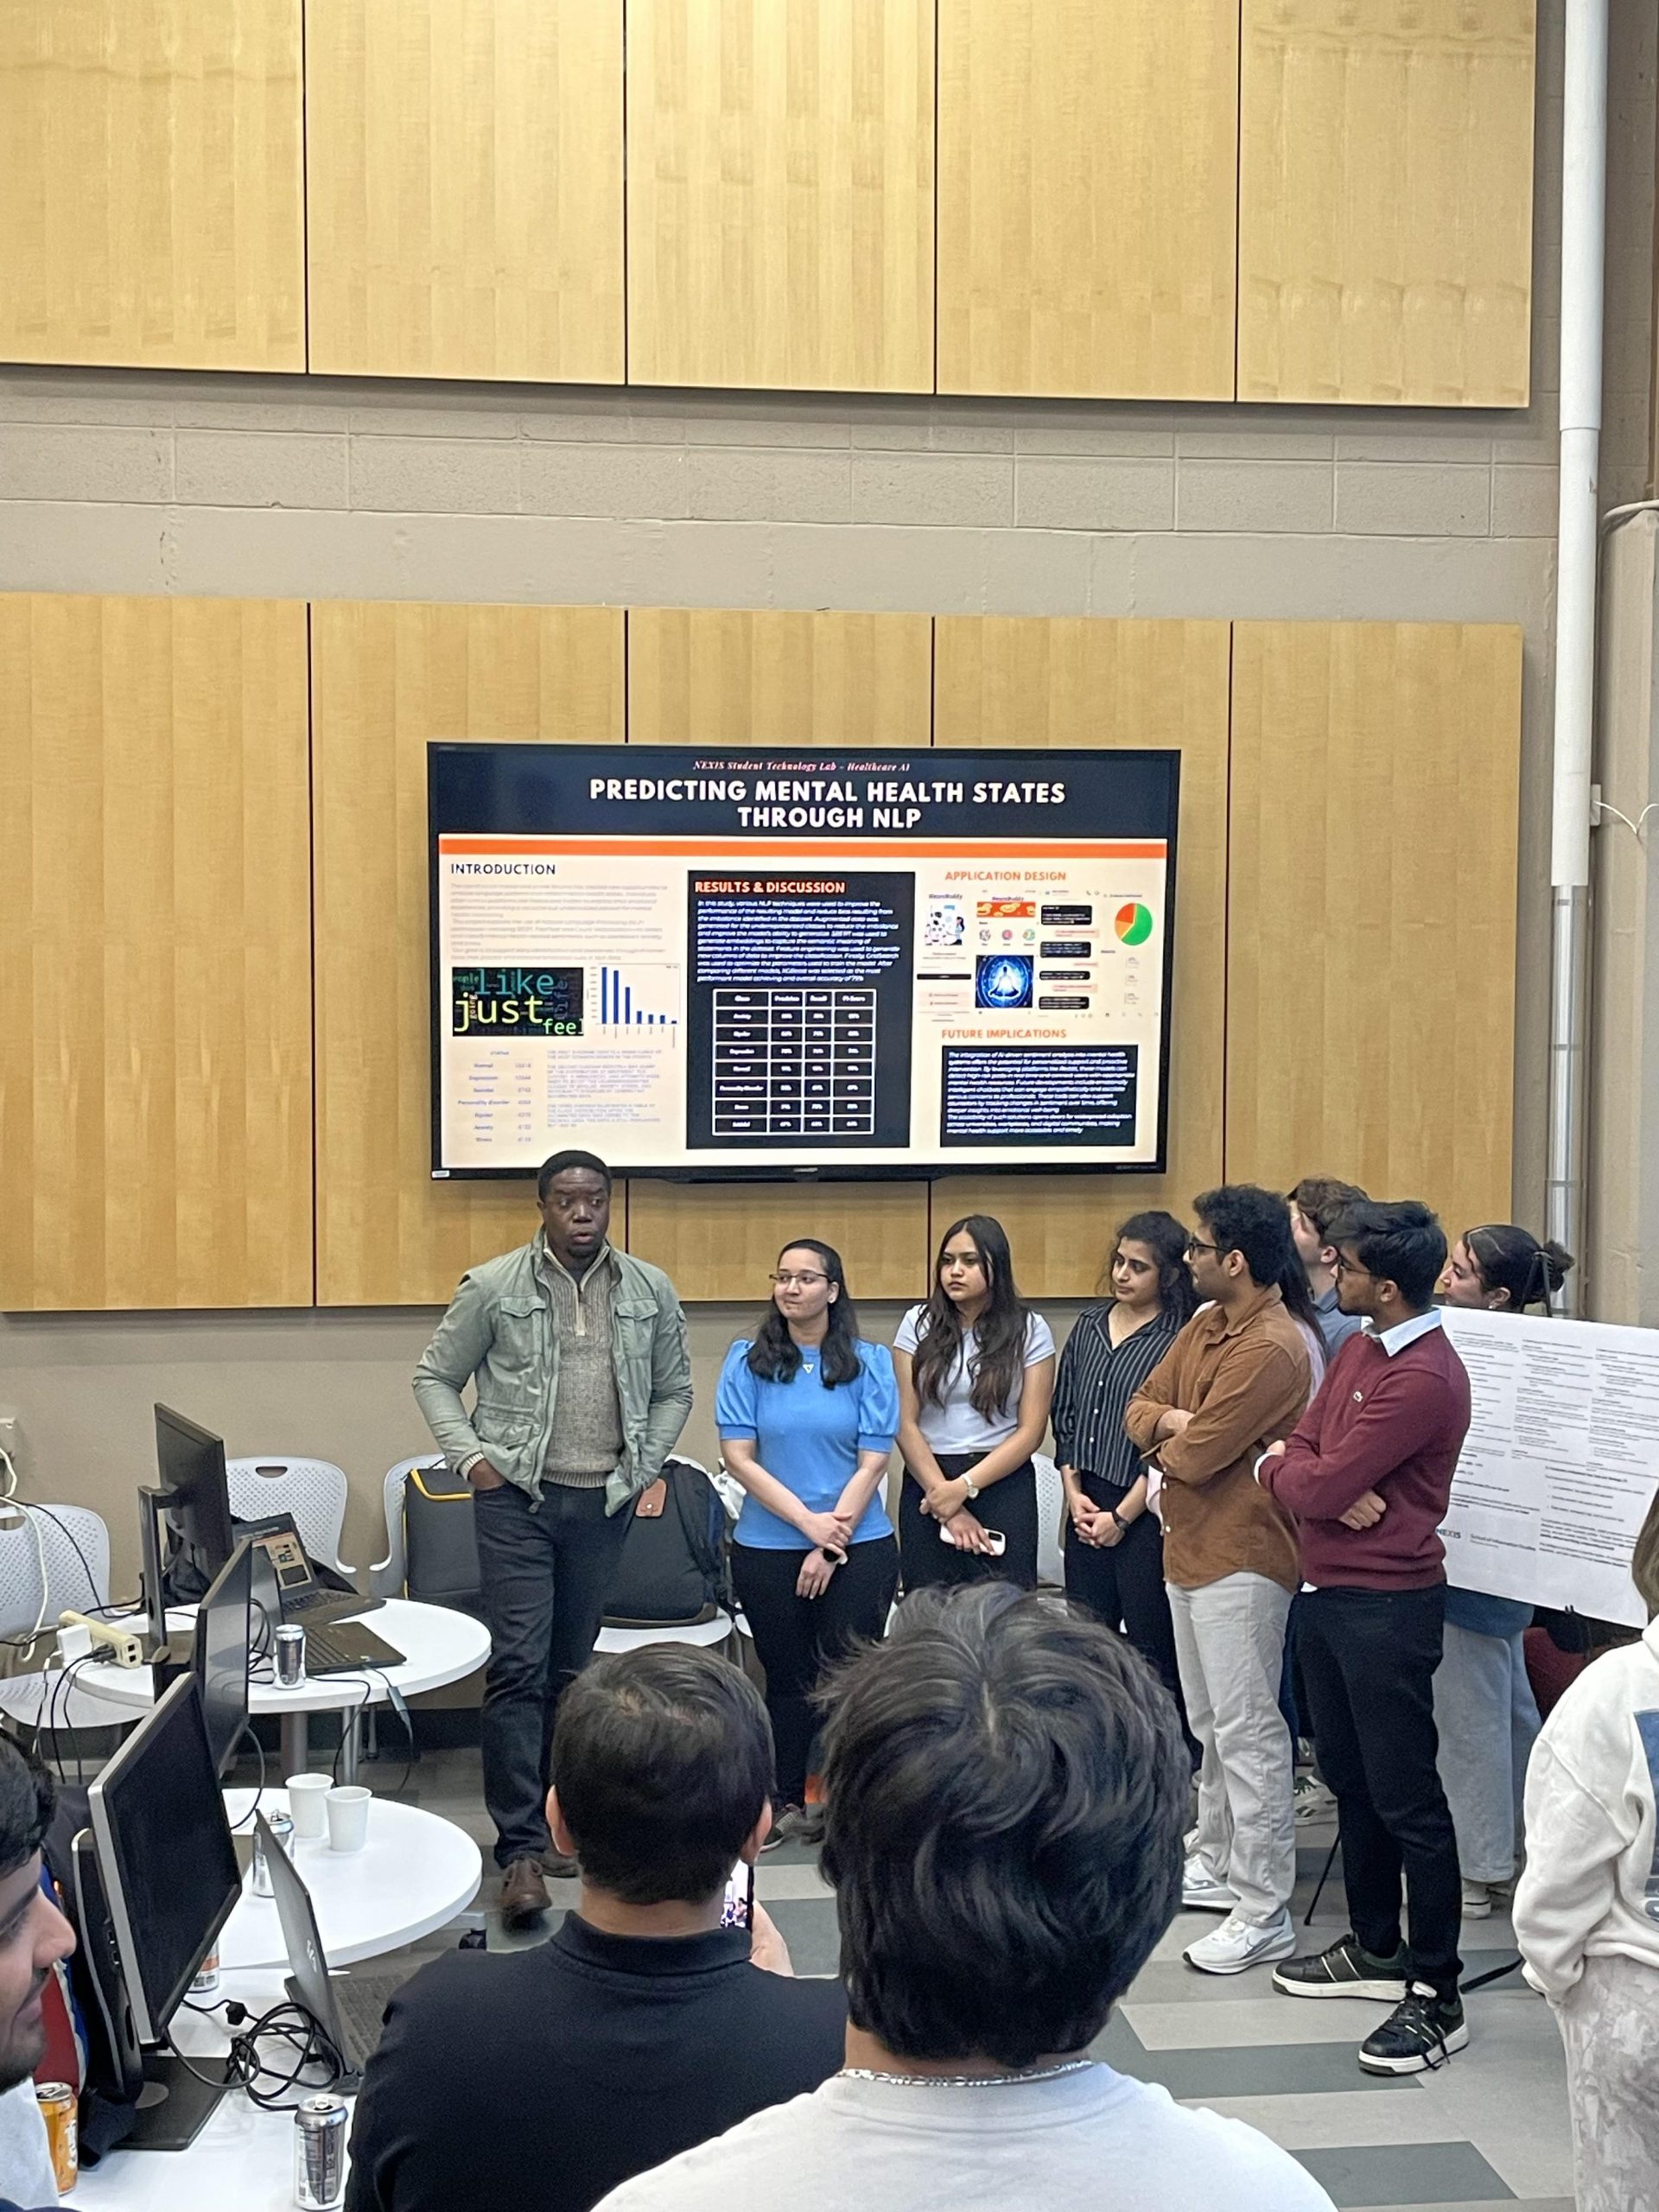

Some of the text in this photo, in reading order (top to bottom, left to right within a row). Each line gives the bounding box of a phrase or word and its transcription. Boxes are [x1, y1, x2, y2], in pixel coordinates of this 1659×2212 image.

[693, 760, 725, 771] NEXIS
[728, 761, 762, 771] Student
[766, 762, 817, 772] Technology
[819, 763, 836, 772] Lab
[847, 763, 897, 772] Healthcare
[899, 763, 910, 772] AI
[589, 779, 1065, 804] PREDICTING MENTAL HEALTH STATES
[738, 806, 921, 829] THROUGH NLP
[451, 864, 556, 875] INTRODUCTION
[944, 871, 1066, 881] APPLICATION DESIGN
[695, 881, 845, 893] RESULTS & DISCUSSION
[474, 968, 554, 995] like
[454, 992, 543, 1033] just
[543, 1019, 584, 1035] feel
[942, 1029, 1066, 1039] FUTURE IMPLICATIONS
[1435, 1528, 1460, 1538] NEXIS
